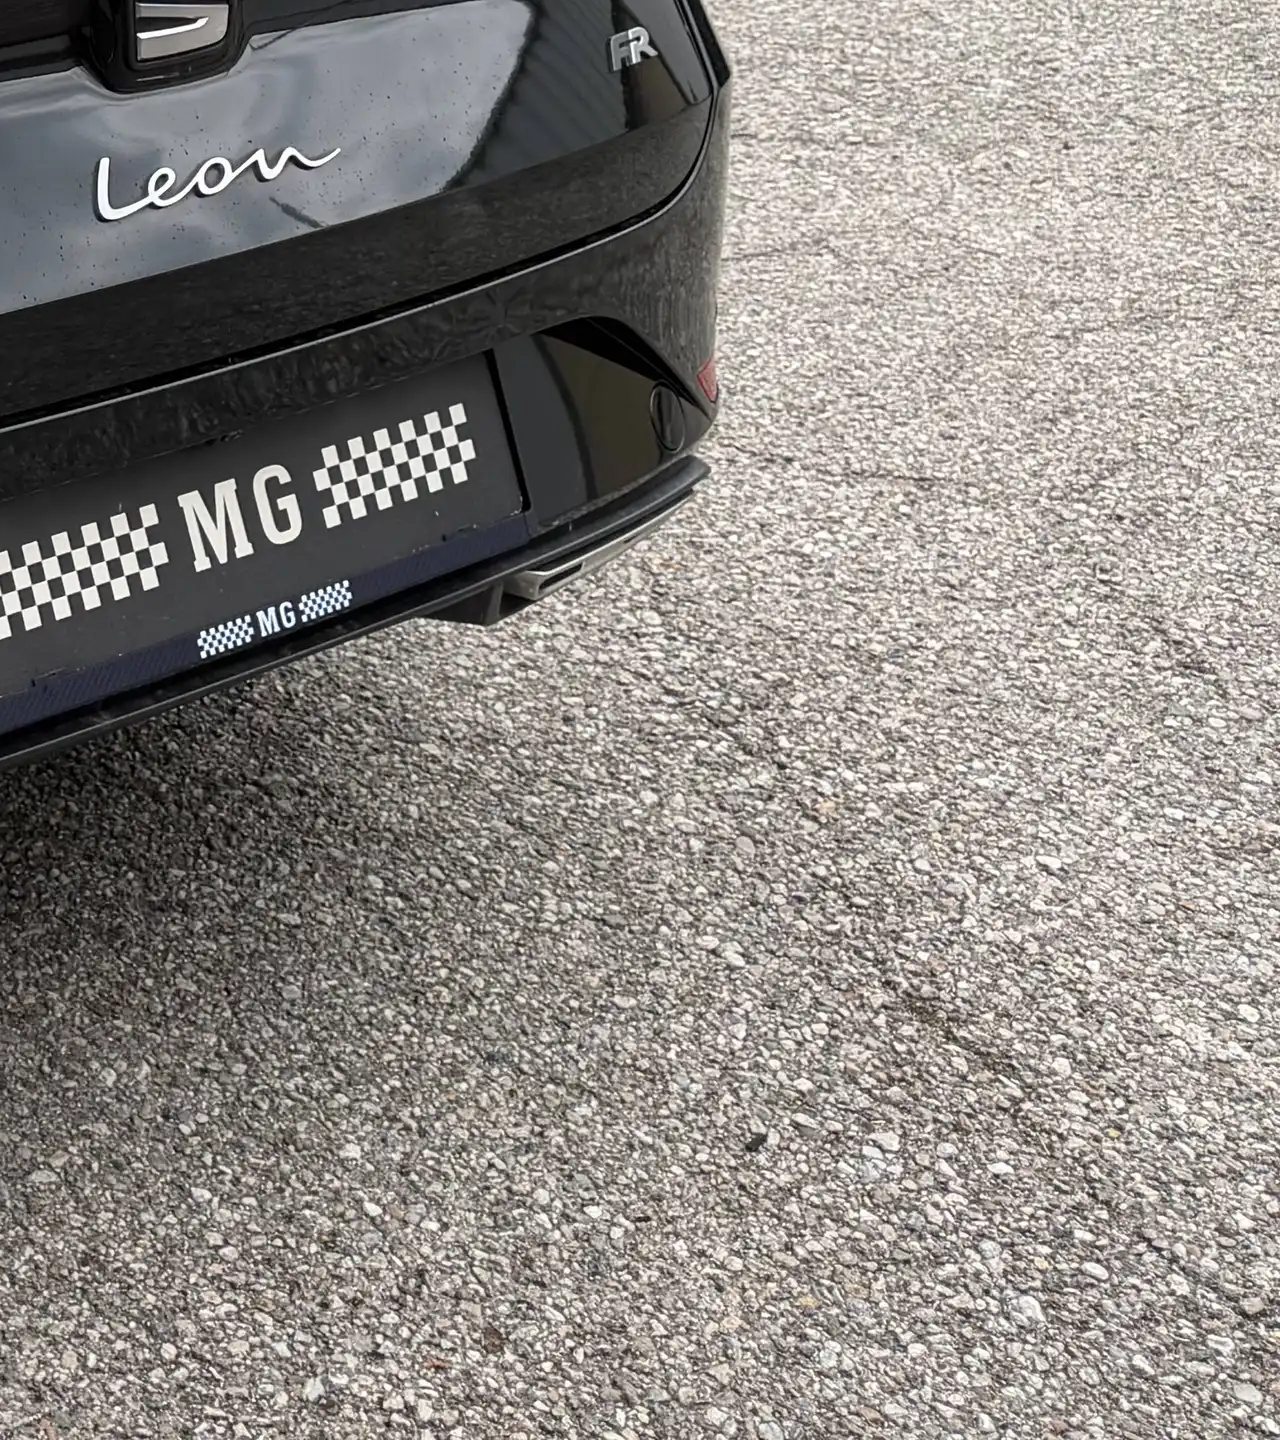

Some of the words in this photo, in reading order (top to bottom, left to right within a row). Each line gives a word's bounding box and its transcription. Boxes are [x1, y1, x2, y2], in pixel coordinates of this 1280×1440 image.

[609, 26, 658, 71] FR
[97, 146, 341, 221] Leon
[177, 464, 303, 572] MG
[256, 601, 296, 637] MG
